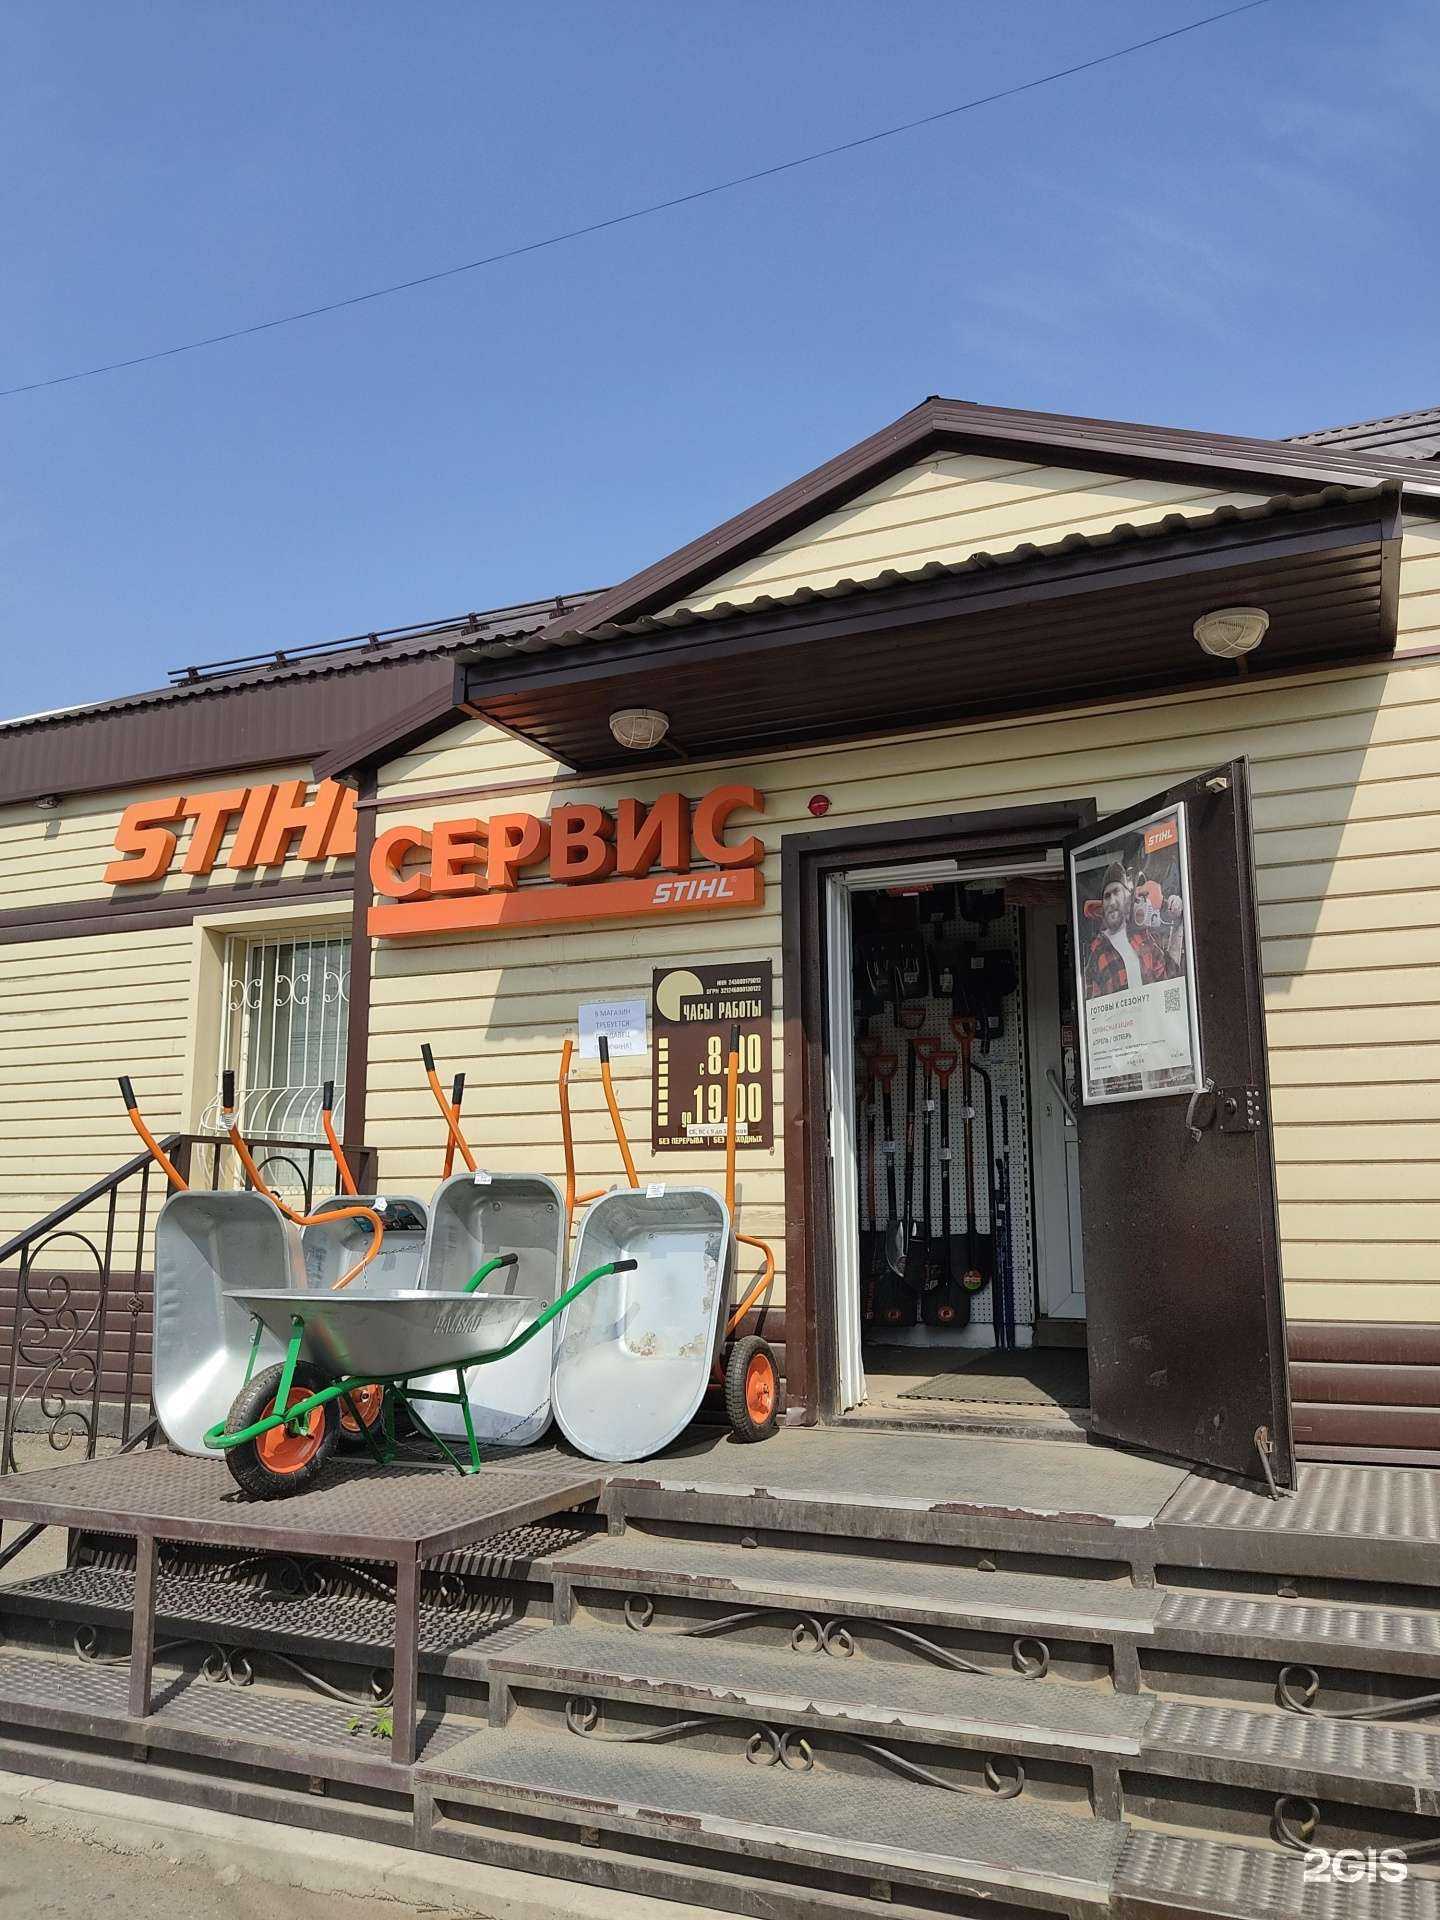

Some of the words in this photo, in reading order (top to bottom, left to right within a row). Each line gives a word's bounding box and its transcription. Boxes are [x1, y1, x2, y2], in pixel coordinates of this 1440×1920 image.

[370, 785, 765, 901] СЕРВИС
[1148, 829, 1173, 846] STIHL
[652, 878, 735, 905] STIHL
[683, 1003, 714, 1021] ЧАСЫ
[718, 999, 762, 1020] РАБОТЫ
[1090, 1002, 1114, 1015] ГОТОВЫ
[1120, 994, 1150, 1008] СЕЗОНУ?
[693, 1082, 762, 1124] 19.00
[658, 1137, 670, 1145] БЕЗ
[671, 1136, 704, 1145] ПЕРЕРЫВА
[713, 1136, 725, 1144] БЕЗ
[735, 1135, 763, 1144] ХОДНЫХ
